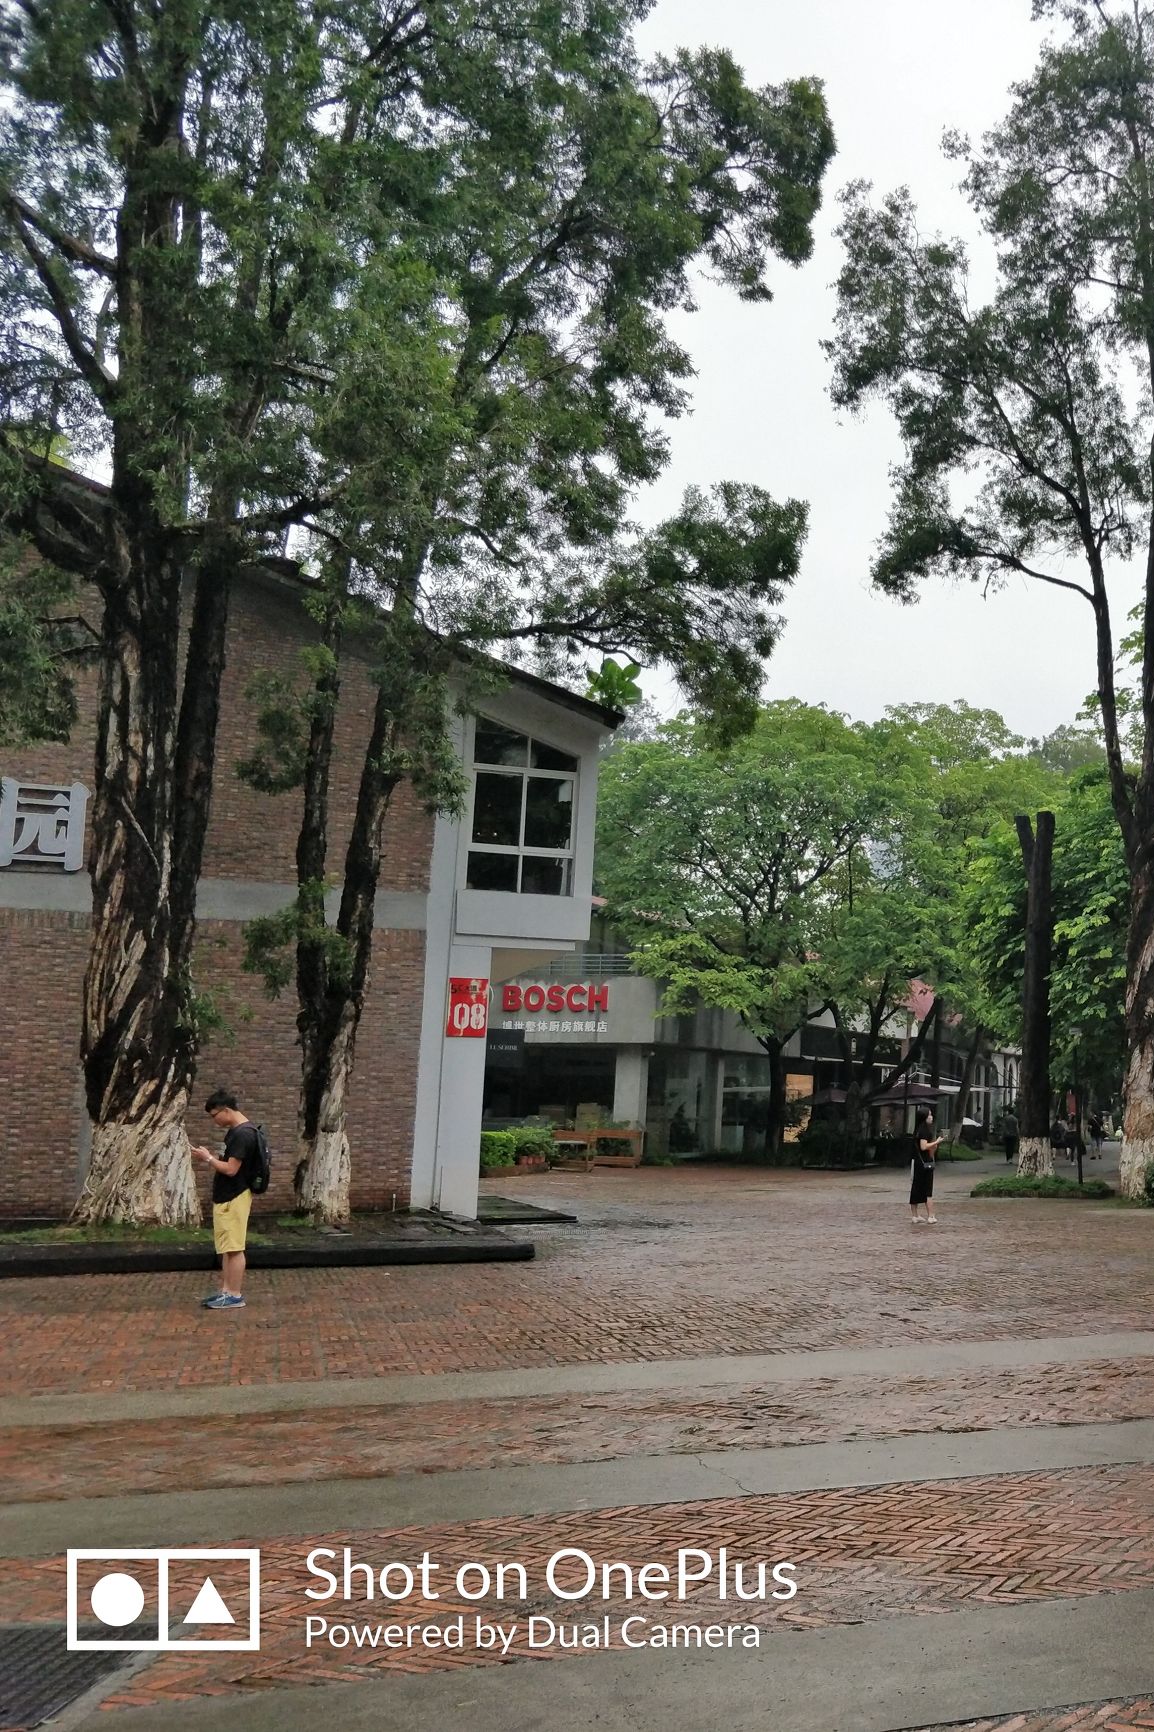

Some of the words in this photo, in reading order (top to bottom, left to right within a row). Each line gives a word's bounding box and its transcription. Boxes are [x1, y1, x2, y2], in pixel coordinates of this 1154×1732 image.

[0, 776, 92, 871] 园
[502, 985, 609, 1012] BOSCH
[453, 1003, 486, 1030] 08
[502, 1020, 608, 1032] 博世整体厨房旗舰店
